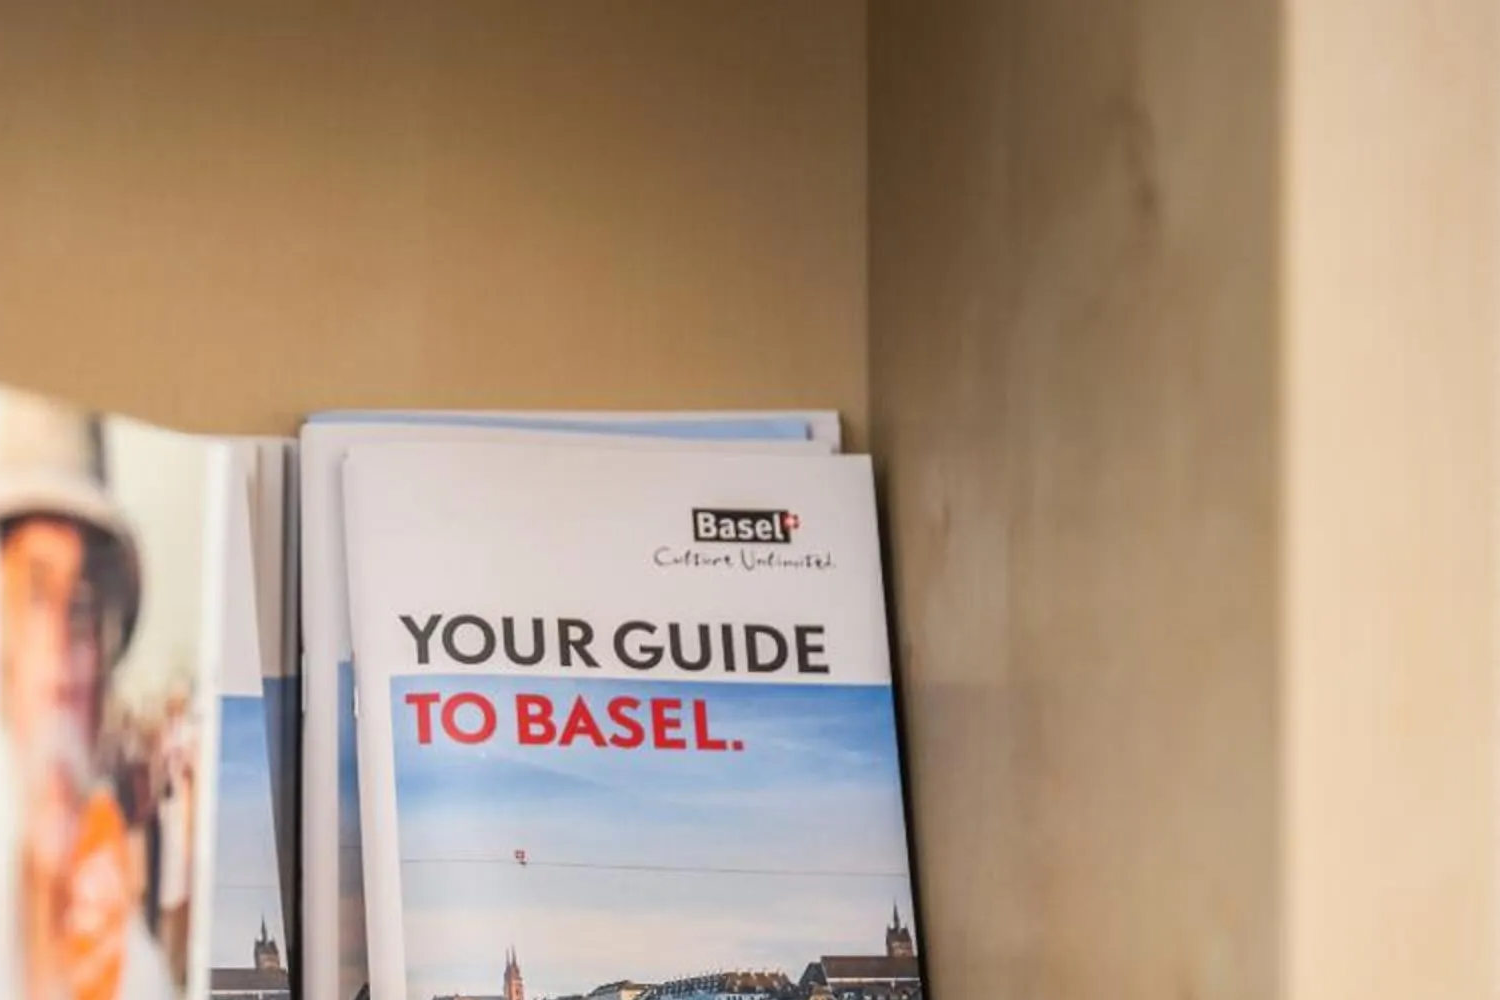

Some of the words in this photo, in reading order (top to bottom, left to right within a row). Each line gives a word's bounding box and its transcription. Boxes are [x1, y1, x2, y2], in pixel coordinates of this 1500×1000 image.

[696, 511, 785, 540] Basel
[652, 545, 734, 567] Culture
[399, 614, 602, 669] YOUR
[612, 621, 831, 674] GUIDE
[404, 692, 497, 745] TO
[515, 693, 745, 751] BASEL.
